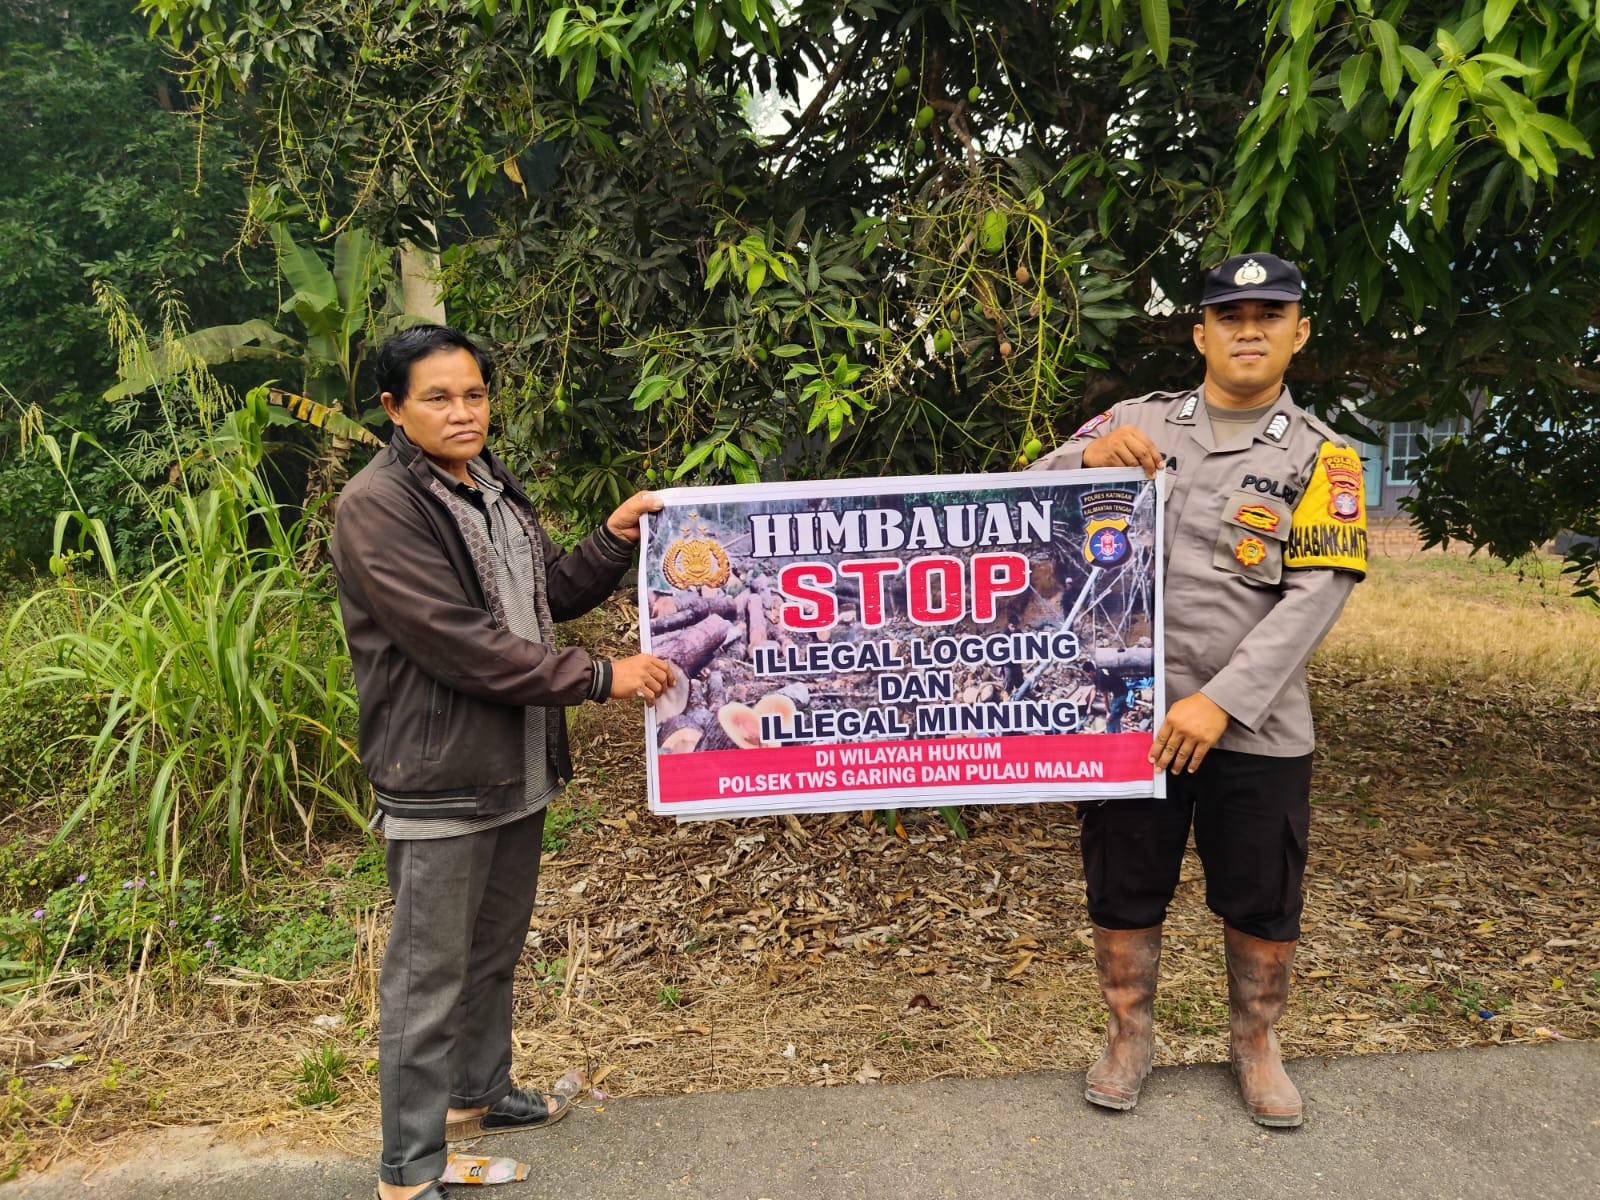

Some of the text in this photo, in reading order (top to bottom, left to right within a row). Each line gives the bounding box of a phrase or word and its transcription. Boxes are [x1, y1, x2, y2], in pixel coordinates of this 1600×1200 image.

[1083, 491, 1133, 503] POLRES KATINGAN
[1241, 474, 1299, 505] POLRI
[1083, 504, 1132, 516] KALIMANTAN TENGAH
[750, 499, 1054, 558] HIMBAUAN
[780, 553, 1030, 631] STOP
[755, 633, 1077, 675] ILLEGAL LOGGING
[880, 673, 952, 702] DAN
[760, 701, 1078, 741] ILLEGAL MINNING
[815, 742, 1002, 768] DI WILAYAH HUKUM
[718, 760, 1104, 795] POLSEK TWS GARING DAN PULAU MALAN
